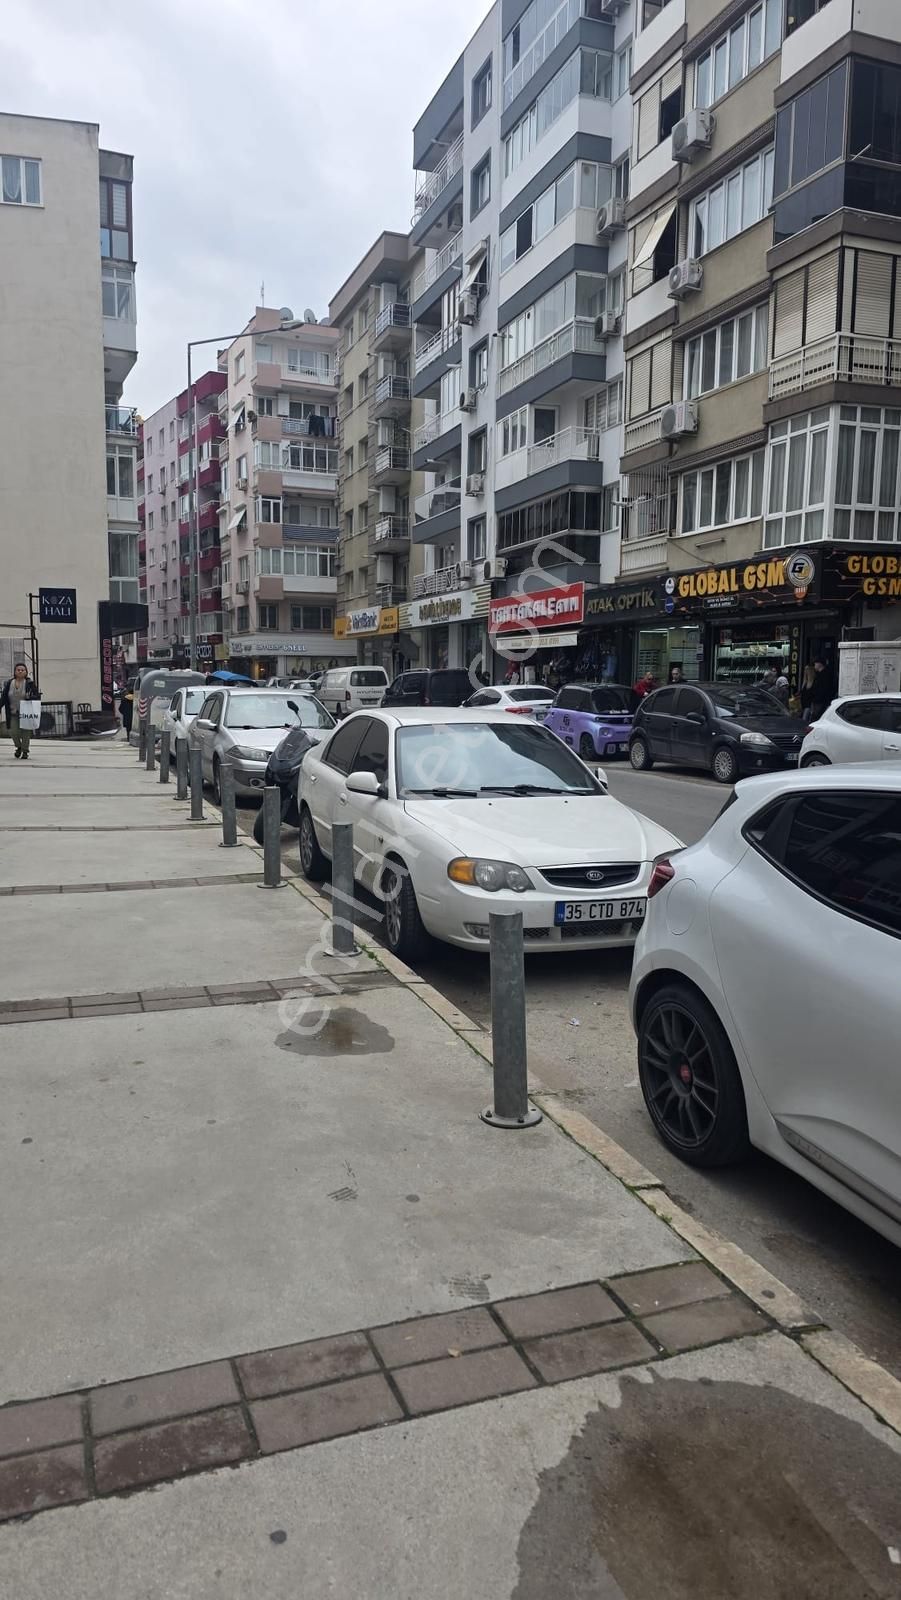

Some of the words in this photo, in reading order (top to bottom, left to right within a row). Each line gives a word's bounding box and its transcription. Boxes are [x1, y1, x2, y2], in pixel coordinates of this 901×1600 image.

[679, 568, 739, 597] GLOBAL
[743, 561, 785, 590] GSM
[586, 597, 615, 615] ATAK
[616, 587, 656, 609] OPTİK
[566, 905, 582, 920] 35
[589, 903, 613, 919] CTD
[620, 901, 643, 917] 874
